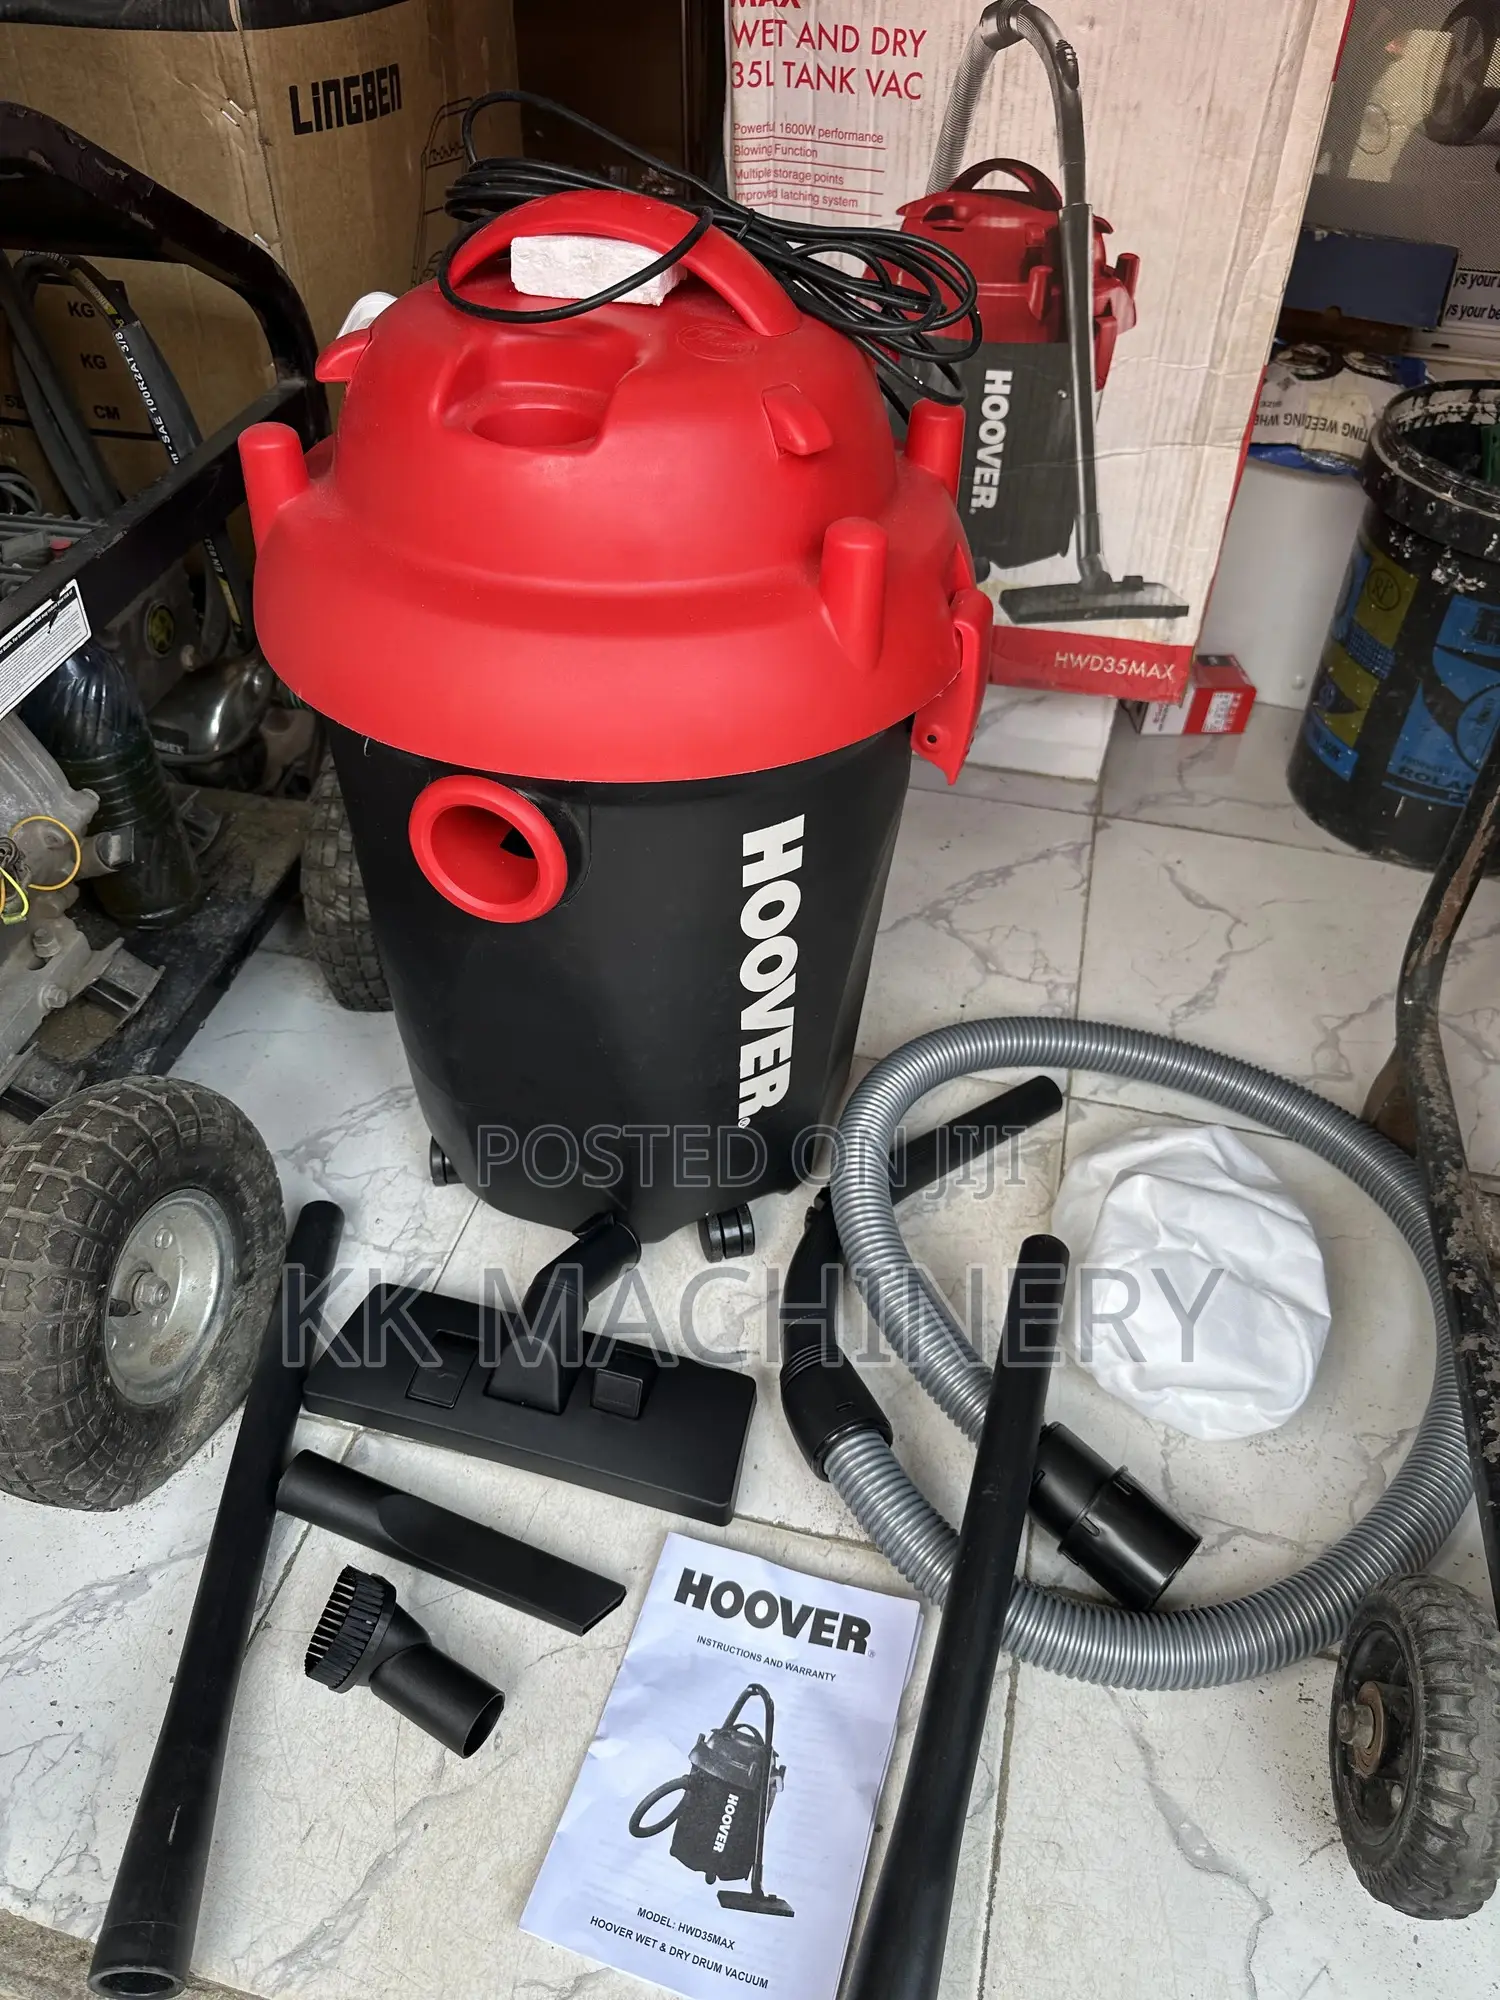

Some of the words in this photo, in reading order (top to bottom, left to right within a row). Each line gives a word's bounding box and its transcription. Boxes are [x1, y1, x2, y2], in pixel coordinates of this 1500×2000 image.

[731, 19, 787, 48] WET
[795, 21, 860, 53] AND
[871, 27, 927, 58] DRY
[730, 60, 775, 89] 35L
[782, 60, 857, 95] TANK
[865, 68, 923, 100] VAC
[733, 121, 776, 135] Powerful
[779, 122, 816, 136] 1600W
[817, 127, 884, 144] performance
[734, 144, 773, 157] Blowing
[774, 143, 818, 158] Function
[734, 167, 772, 180] Multiple
[773, 167, 812, 183] storage
[813, 173, 844, 185] points
[734, 188, 778, 203] Improved
[780, 189, 820, 205] latching
[822, 195, 859, 208] system
[1467, 274, 1498, 290] your
[67, 301, 95, 318] KG
[1458, 304, 1488, 320] your
[114, 331, 130, 353] 3/8
[80, 353, 107, 370] KG
[125, 356, 158, 414] 100R2AT
[93, 405, 120, 420] CM
[152, 416, 171, 444] SAE
[970, 369, 1013, 510] HOOVER
[1054, 651, 1176, 682] HWD35MAX
[738, 813, 805, 1122] HOOVER
[673, 1566, 872, 1655] HOOVER
[696, 1635, 763, 1663] INSTRUCTIONS
[763, 1656, 783, 1669] AND
[785, 1661, 836, 1682] WARRANTY
[712, 1793, 739, 1853] HOOVER
[636, 1907, 676, 1929] MODEL:
[677, 1921, 736, 1951] HWD35MAX
[590, 1915, 634, 1940] HOOVER
[635, 1932, 658, 1949] WET
[658, 1942, 667, 1953] &
[668, 1945, 691, 1962] DRY
[691, 1954, 723, 1974] DRUM
[725, 1965, 769, 1989] VACUUM
